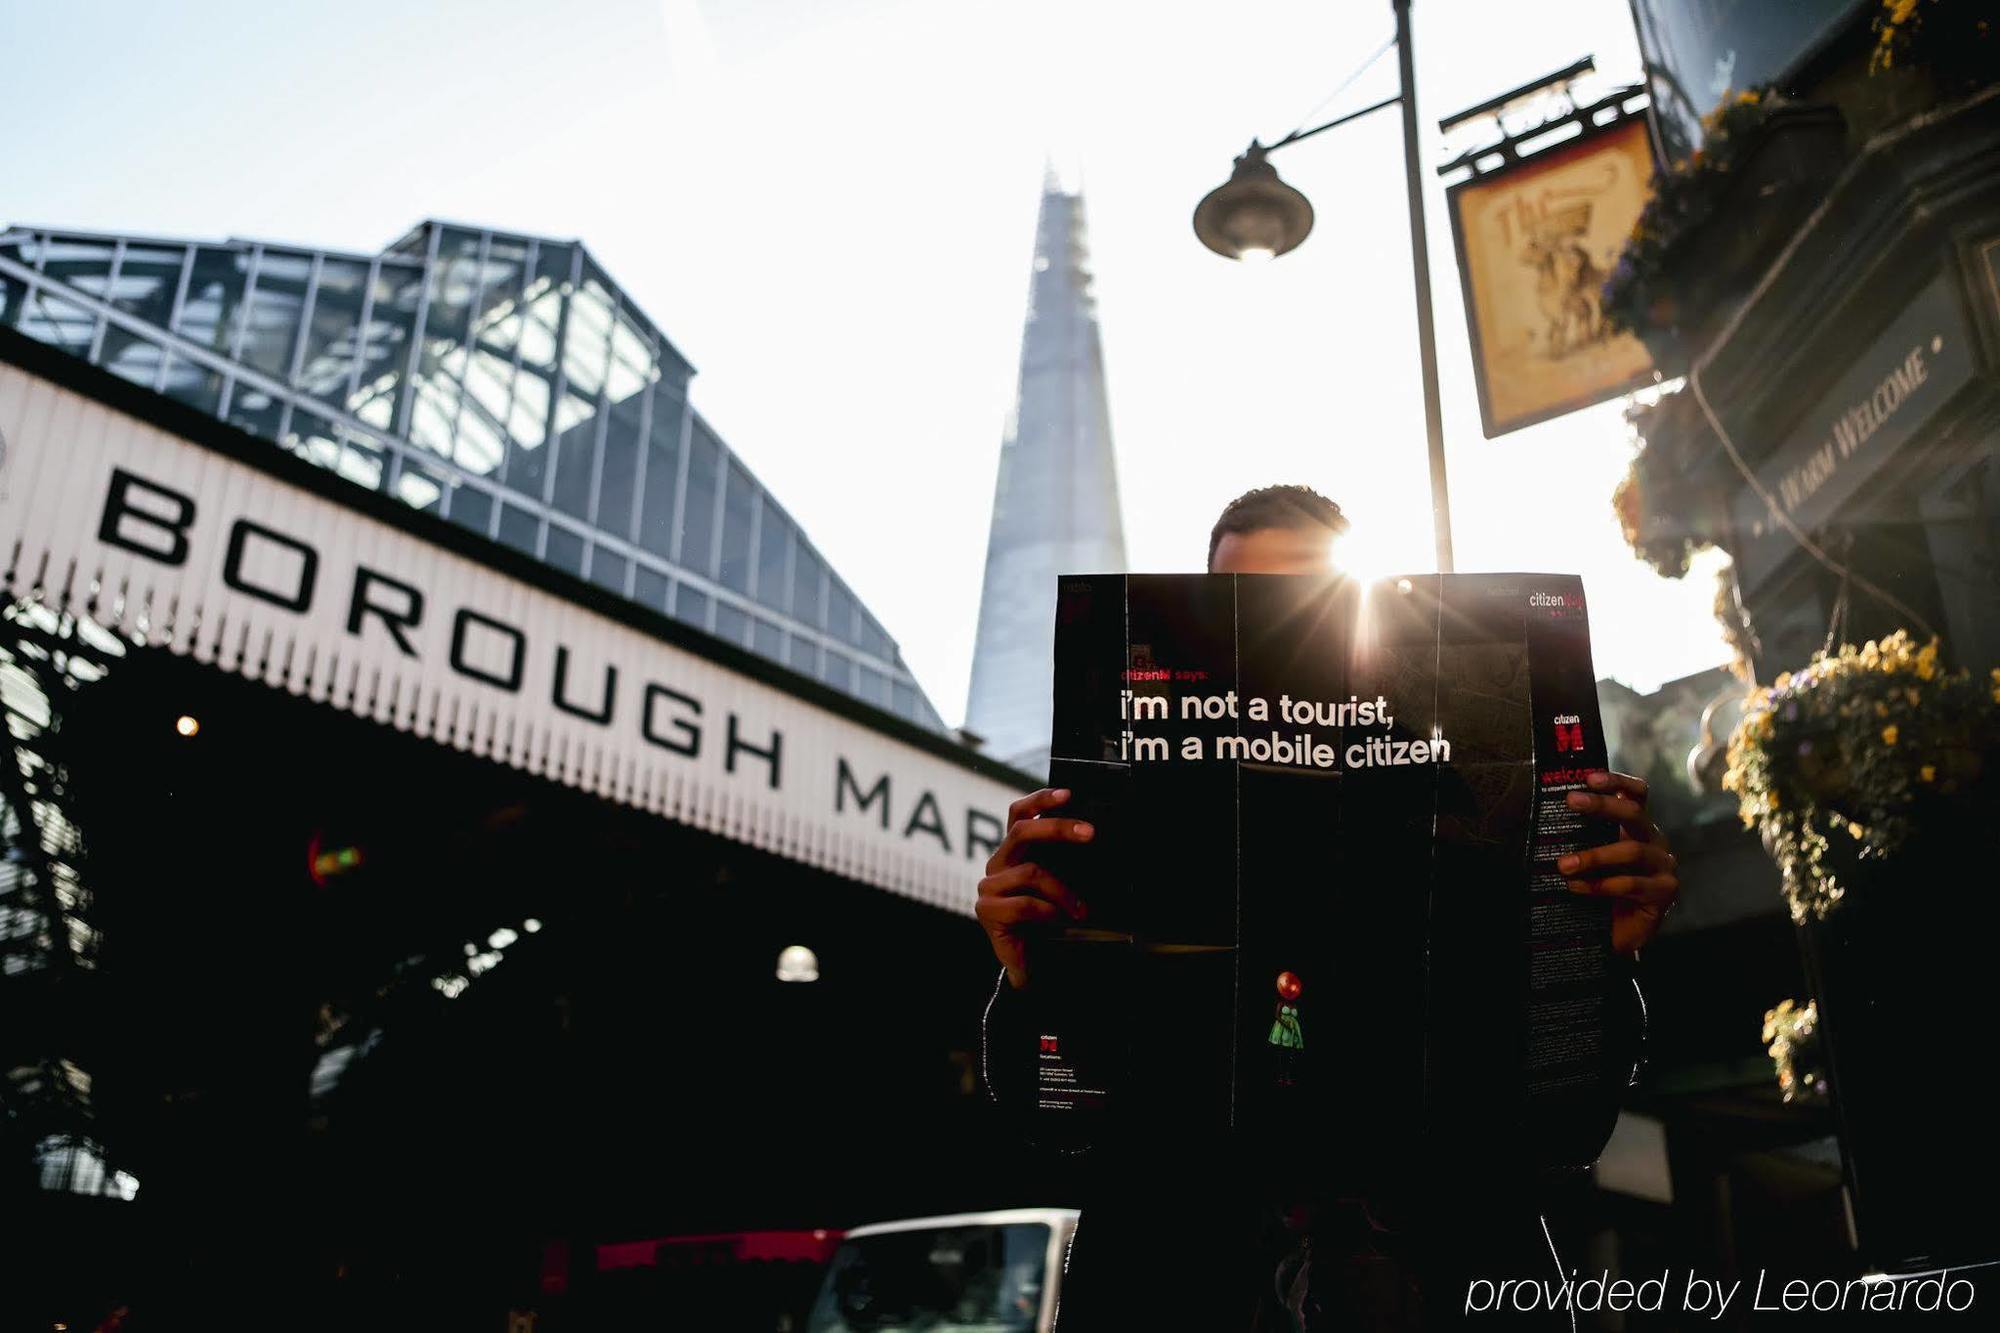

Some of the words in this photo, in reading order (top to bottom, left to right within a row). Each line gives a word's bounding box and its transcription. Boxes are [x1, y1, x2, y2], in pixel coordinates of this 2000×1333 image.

[1833, 345, 1929, 459] WELCOME
[98, 466, 783, 790] BOROUGH
[1121, 690, 1169, 720] i'm
[1181, 691, 1239, 720] not
[1248, 697, 1270, 722] a
[1279, 694, 1394, 730] tourist,
[1121, 731, 1169, 761] i'm
[1181, 736, 1203, 760] a
[1216, 733, 1335, 767] mobile
[1344, 734, 1451, 769] citizen
